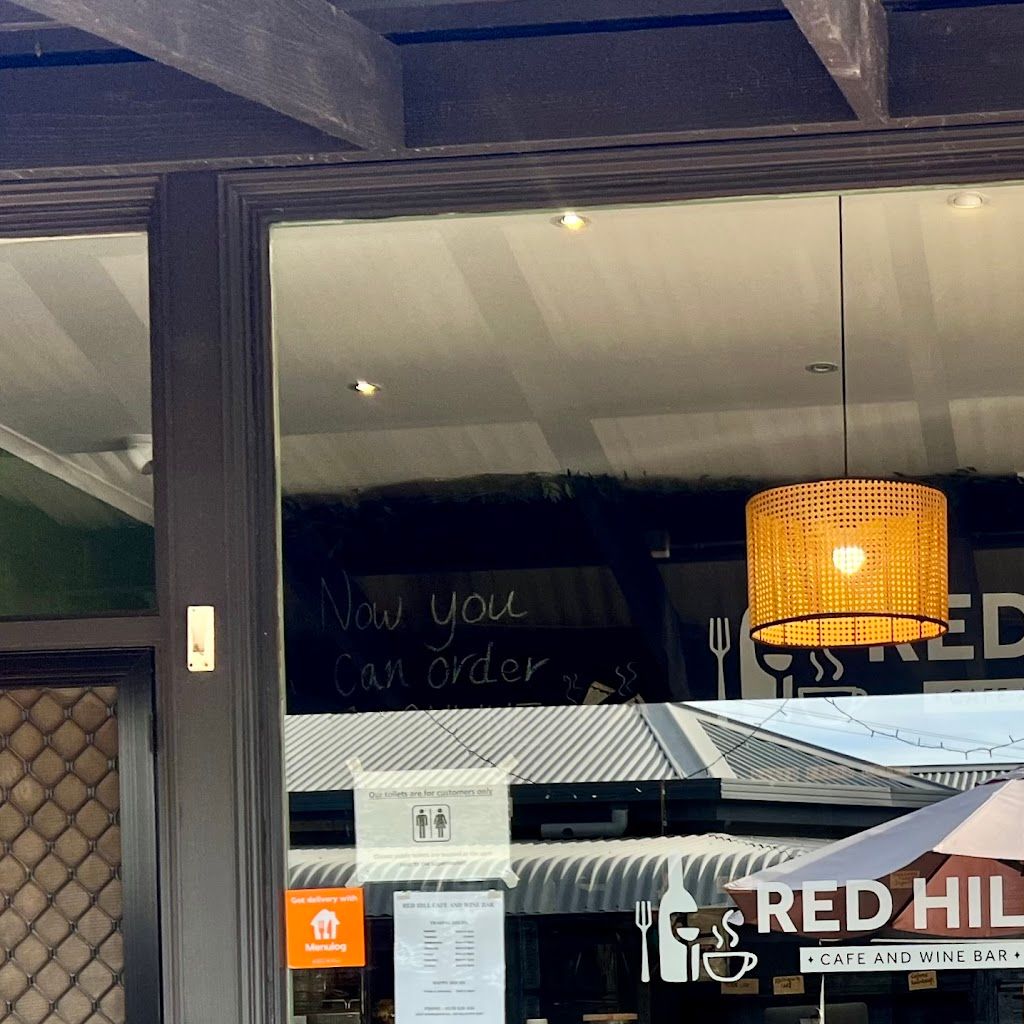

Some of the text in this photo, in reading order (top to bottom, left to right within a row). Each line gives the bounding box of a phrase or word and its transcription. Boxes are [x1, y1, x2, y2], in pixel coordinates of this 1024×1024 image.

[321, 569, 528, 651] Now you
[428, 641, 550, 690] order
[424, 788, 435, 797] for
[436, 788, 475, 797] customers
[477, 787, 493, 797] only
[290, 894, 358, 904] Get delivery with
[757, 879, 893, 933] RED
[304, 942, 347, 953] Menulog
[820, 949, 1008, 966] CAFE AND WINE BAR
